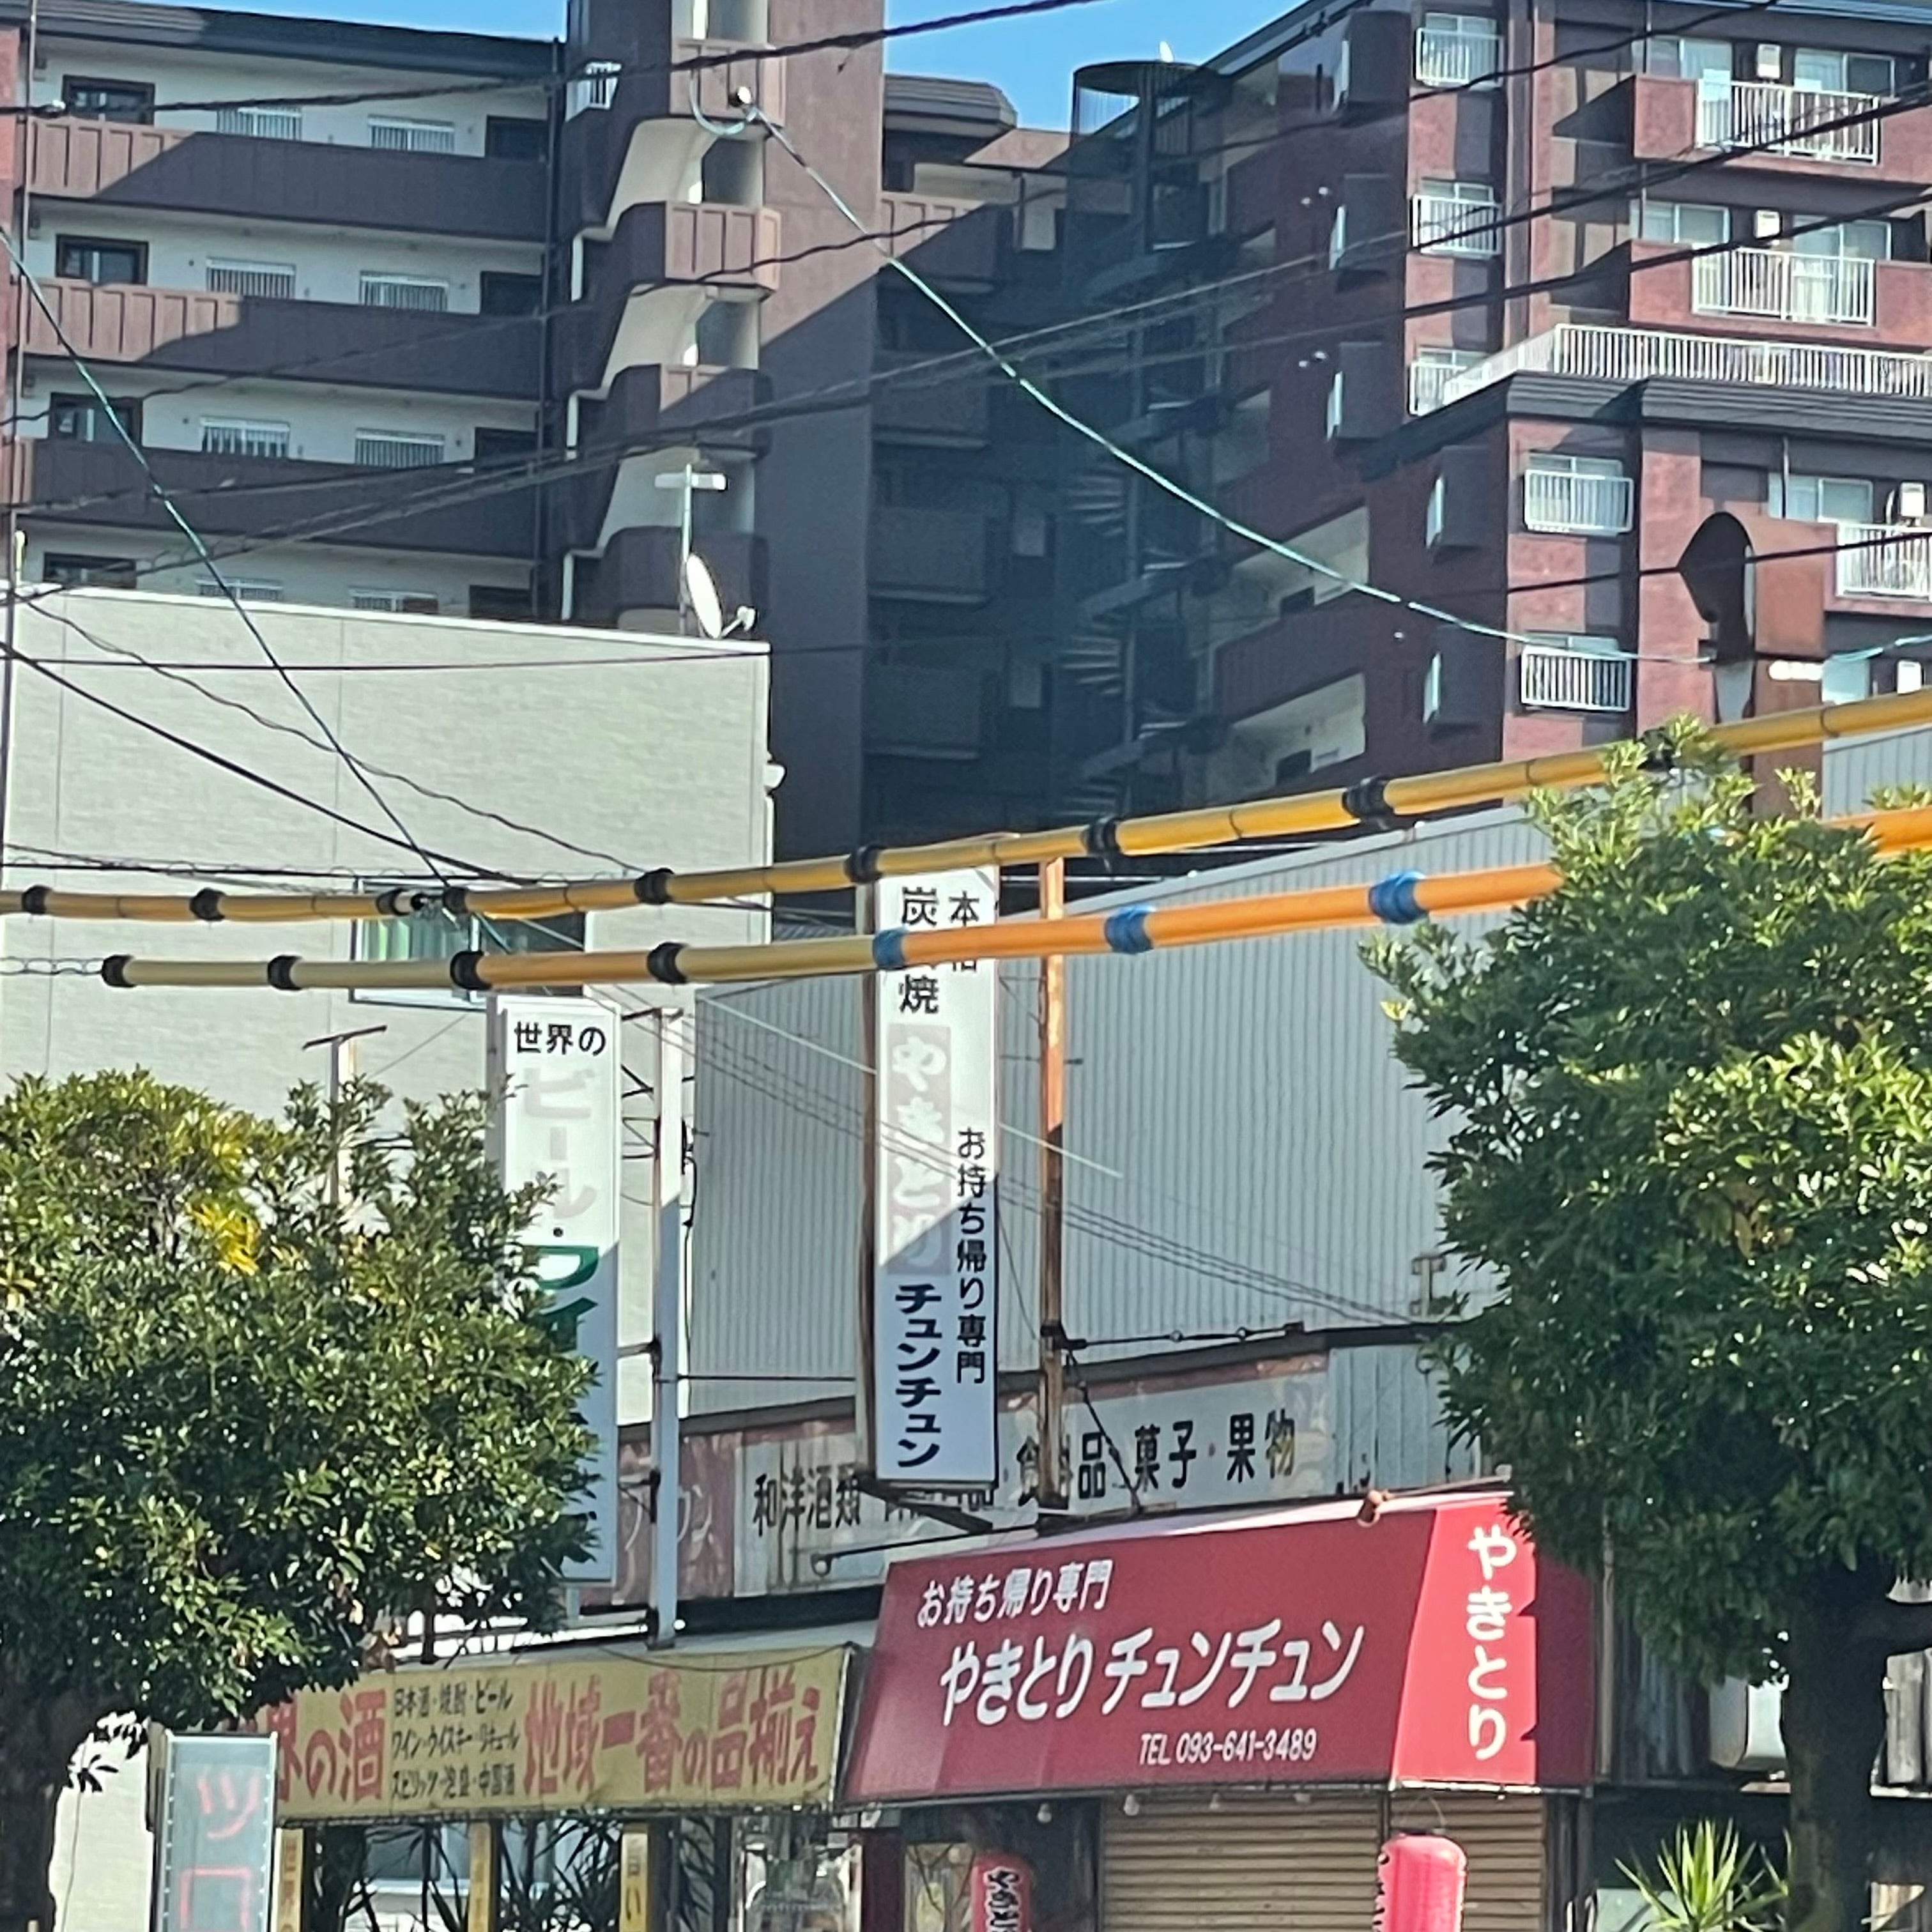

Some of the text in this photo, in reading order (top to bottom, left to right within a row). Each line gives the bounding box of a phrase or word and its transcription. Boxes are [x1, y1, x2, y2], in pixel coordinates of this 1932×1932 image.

[899, 887, 939, 1014] 炭焼
[948, 891, 980, 972] 本
[514, 1022, 606, 1055] 世界の
[892, 1037, 947, 1268] やきとり
[957, 1127, 987, 1384] お持ち帰り専門
[894, 1284, 942, 1468] チュンチュン
[917, 1560, 1114, 1628] お持ち帰り専門
[1466, 1524, 1517, 1760] やきとり
[1140, 1728, 1317, 1766] TEL 093-641-3489
